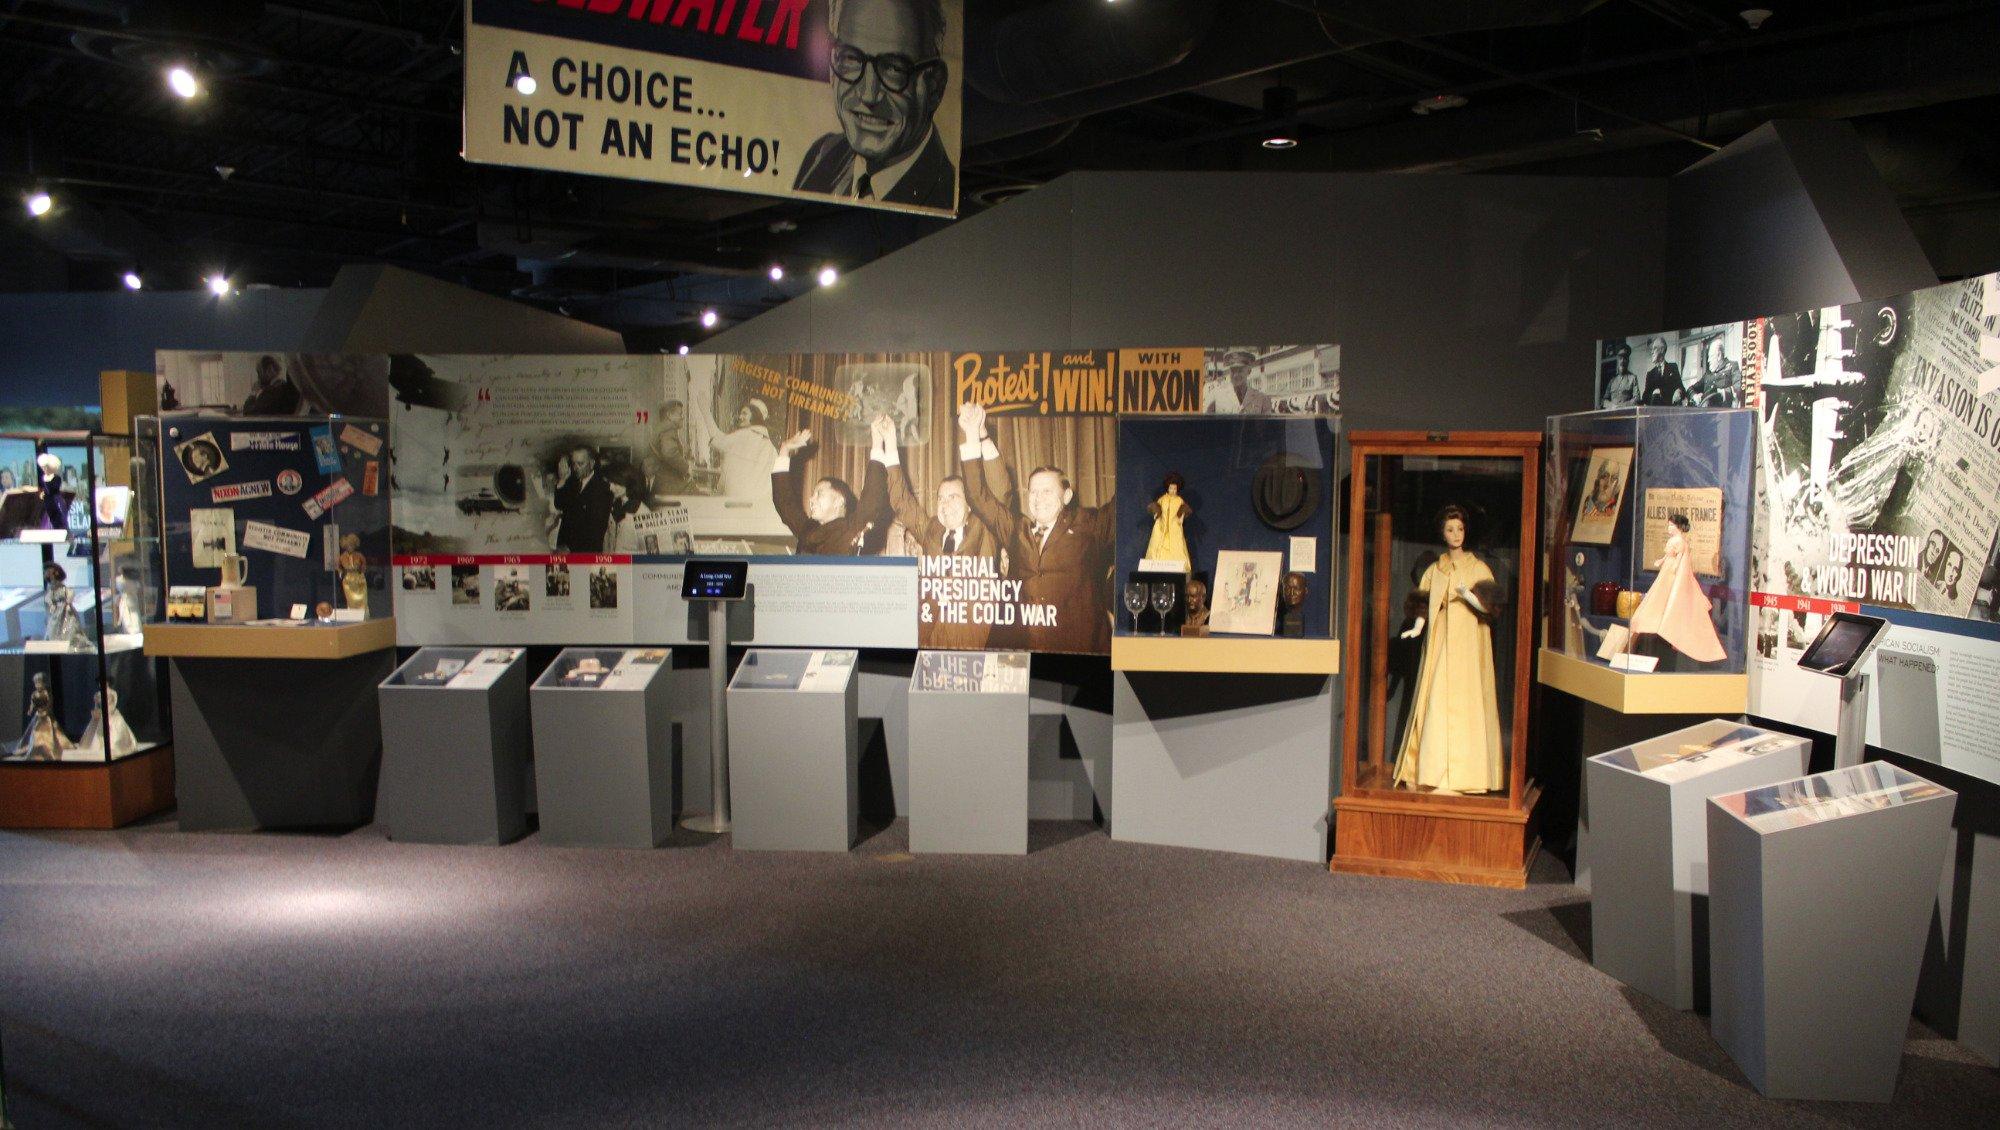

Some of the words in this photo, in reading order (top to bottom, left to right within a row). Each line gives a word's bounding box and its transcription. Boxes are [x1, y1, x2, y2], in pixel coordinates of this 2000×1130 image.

[505, 50, 533, 89] A
[552, 57, 725, 118] CHOICE...
[503, 104, 584, 151] NOT
[600, 117, 653, 160] AN
[670, 127, 780, 177] ECHO!
[1960, 292, 1983, 321] BLITZ
[731, 357, 780, 384] REGISTER
[1063, 350, 1095, 365] and
[1138, 353, 1181, 364] WITH
[1746, 320, 1757, 406] ROOSEVELT
[954, 352, 1050, 415] Protest!
[1053, 352, 1115, 413] WIN!
[1123, 369, 1200, 412] NIXON
[1912, 355, 1979, 426] INVASION
[1974, 403, 1992, 438] IS
[213, 487, 240, 499] NIXON
[1646, 506, 1666, 520] ALLIES
[1691, 507, 1717, 522] FRANCE
[1829, 533, 1919, 569] DEPRESSION
[921, 555, 999, 578] IMPERIAL
[921, 578, 1023, 602] PRESIDENCY
[1801, 566, 1811, 593] &
[1816, 565, 1867, 598] WORLD
[1871, 569, 1903, 603] WAR
[1906, 572, 1918, 604] II
[921, 602, 933, 623] &
[938, 601, 968, 624] THE
[972, 603, 1015, 625] COLD
[1020, 603, 1057, 627] WAR
[1879, 653, 1897, 665] WHAT
[1899, 658, 1939, 674] HAPPENED?
